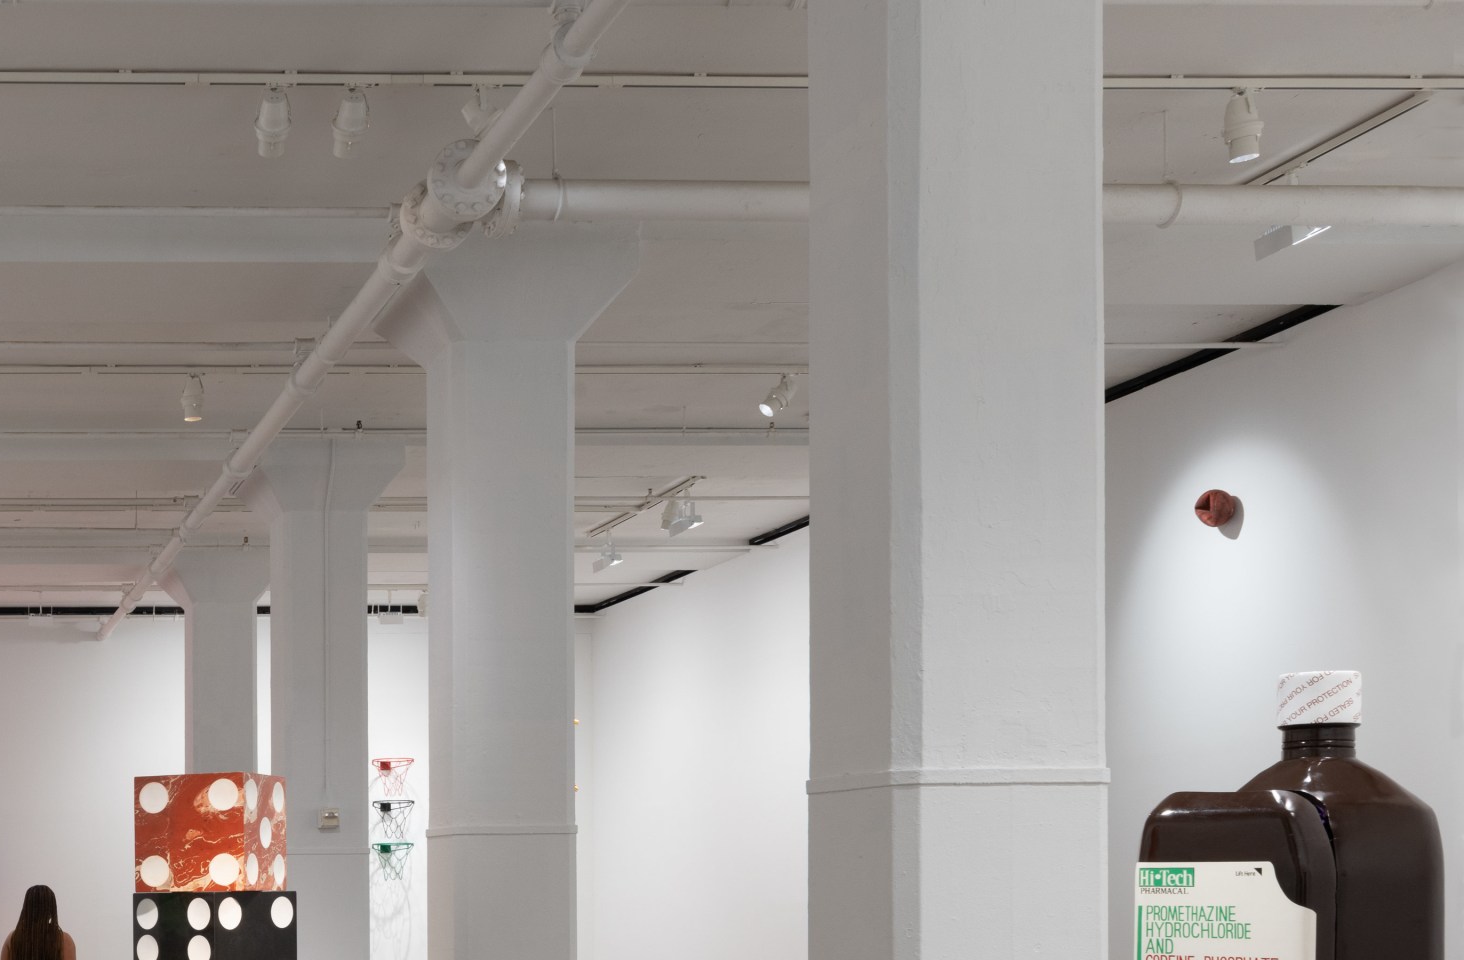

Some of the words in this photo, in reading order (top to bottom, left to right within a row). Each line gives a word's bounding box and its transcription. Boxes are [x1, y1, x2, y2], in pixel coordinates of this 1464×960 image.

[1287, 706, 1307, 721] YOUR
[1306, 678, 1353, 709] PROTECTION
[1328, 697, 1354, 717] SEALED
[1146, 905, 1236, 921] PROMETHAZINE
[1145, 922, 1252, 939] HYDROCHLORIDE
[1145, 938, 1174, 954] AND
